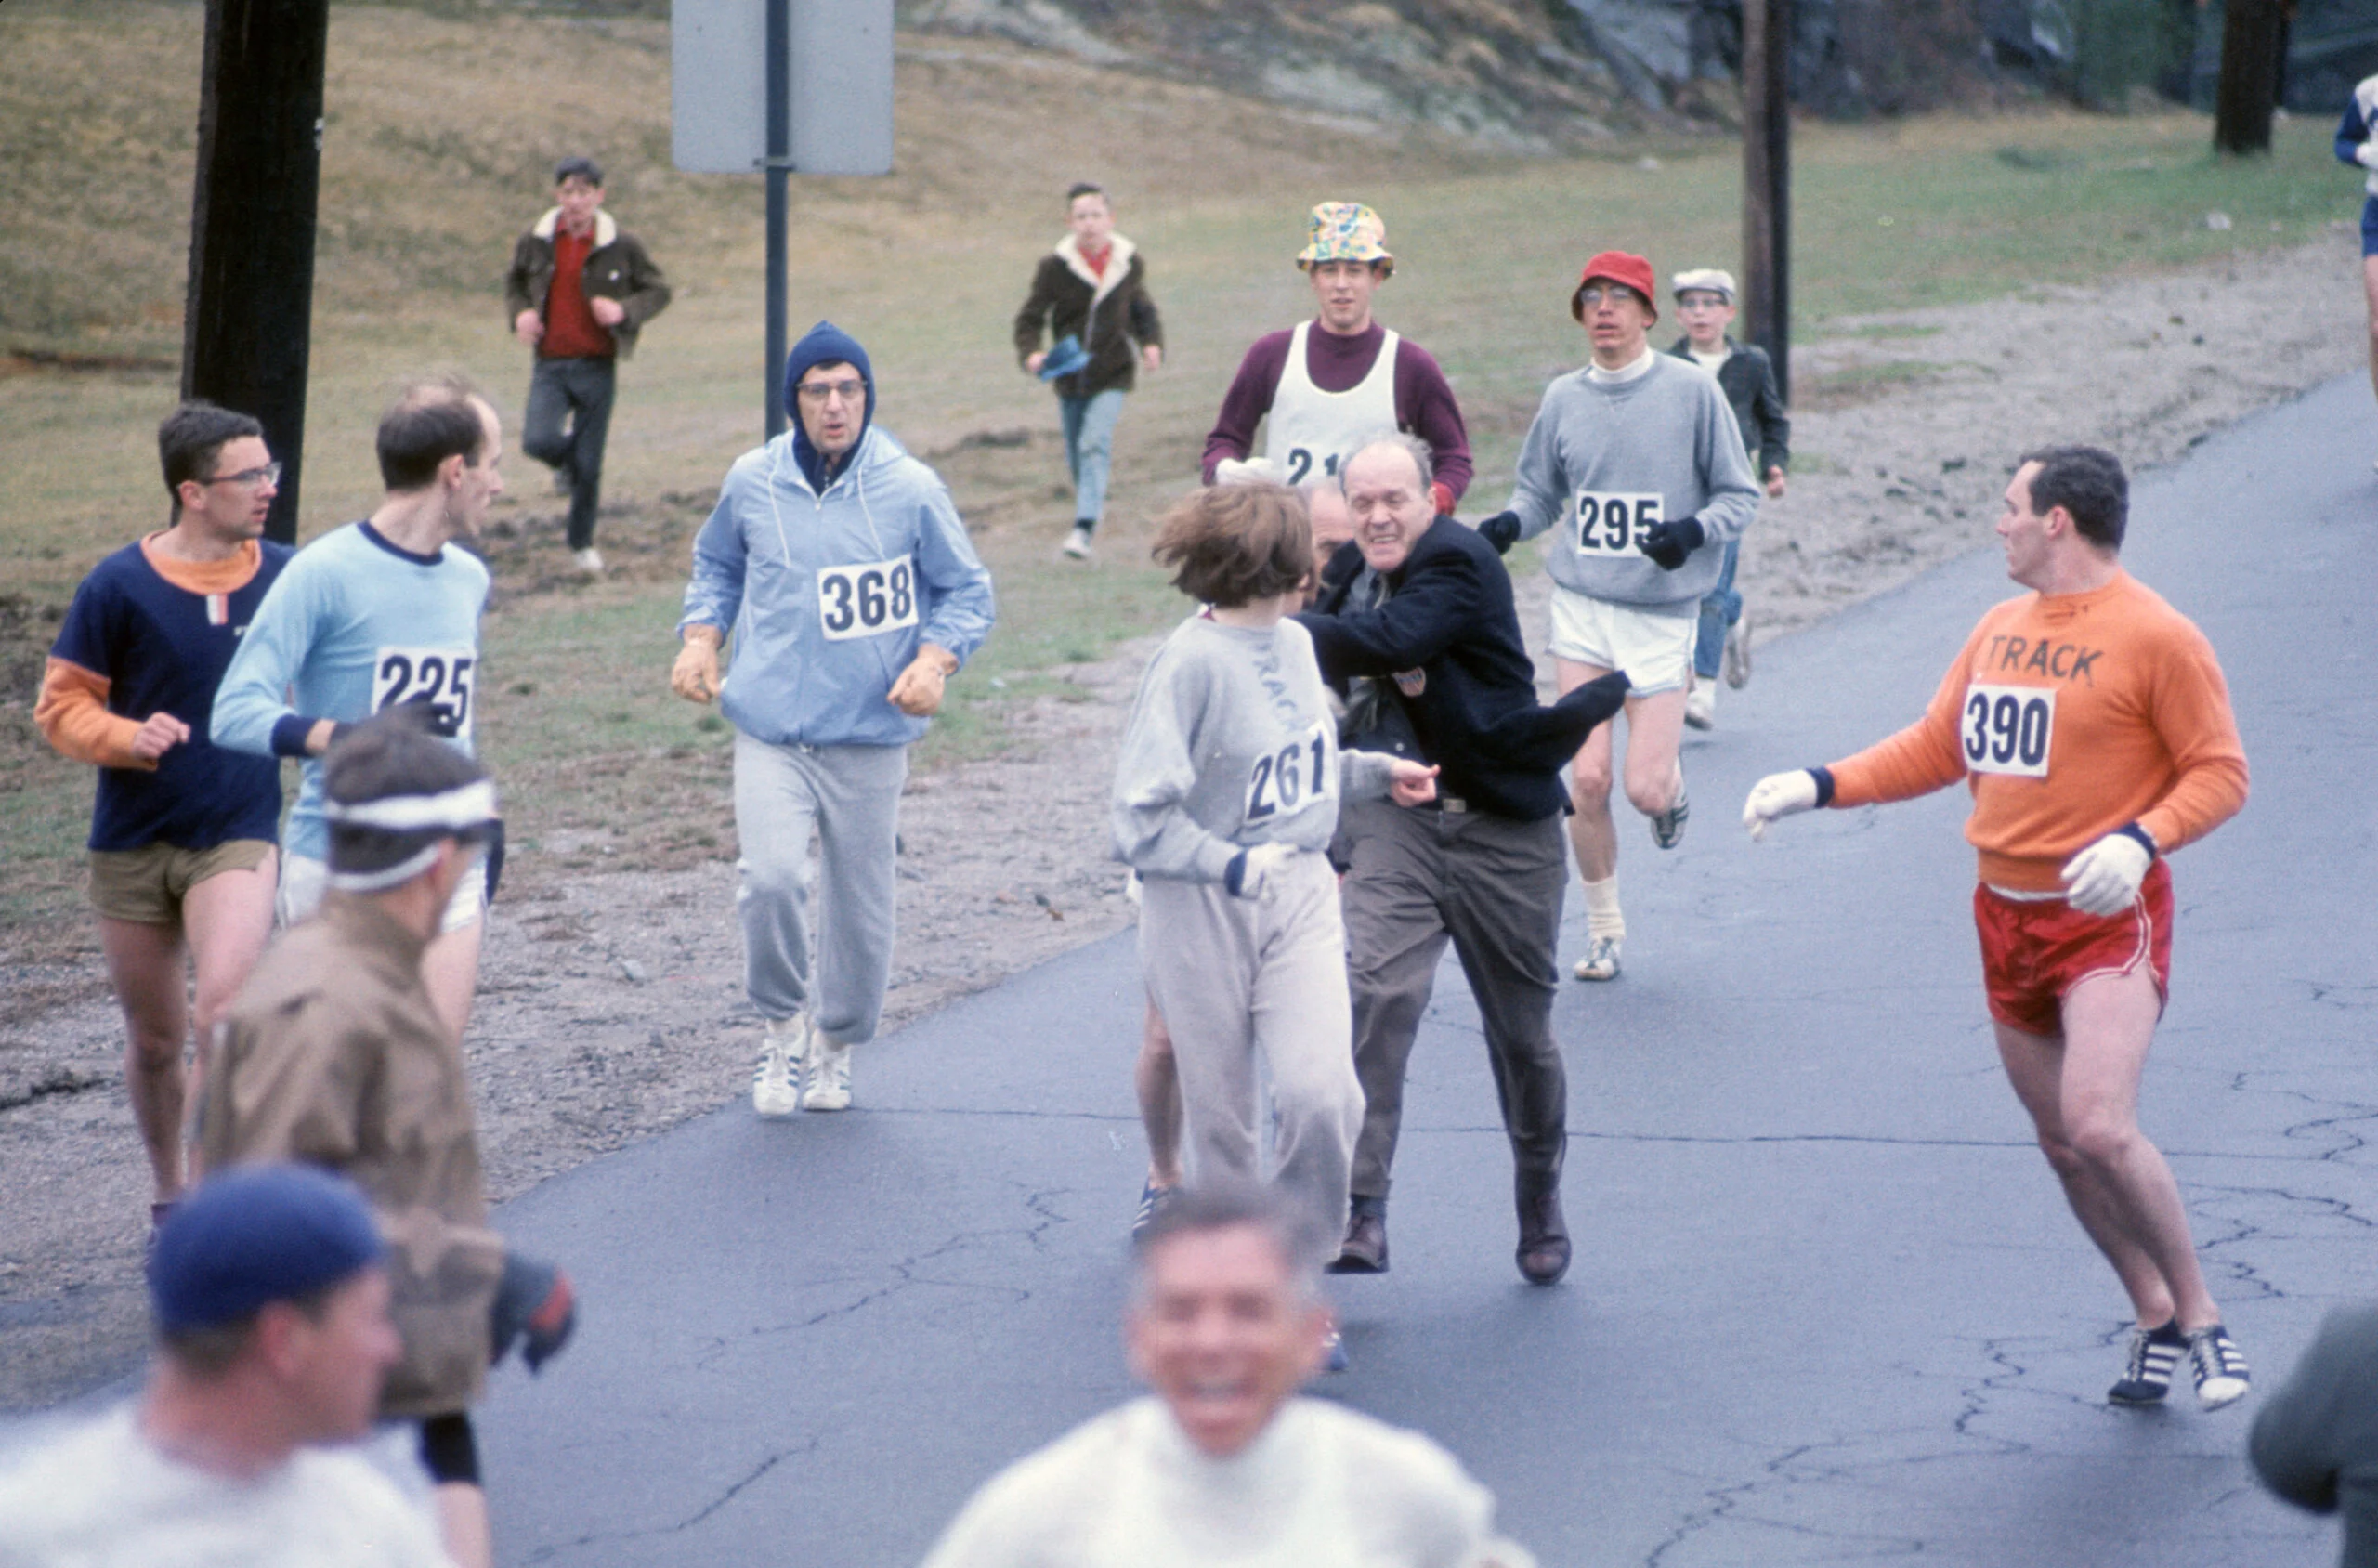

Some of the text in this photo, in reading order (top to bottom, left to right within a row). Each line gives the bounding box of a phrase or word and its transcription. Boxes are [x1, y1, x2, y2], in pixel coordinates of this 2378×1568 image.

[1580, 496, 1658, 551] 295
[823, 563, 910, 632] 368
[380, 655, 472, 727] 225
[1986, 635, 2104, 687] TRACK
[1966, 692, 2049, 766] 390
[1248, 729, 1324, 819] 261
